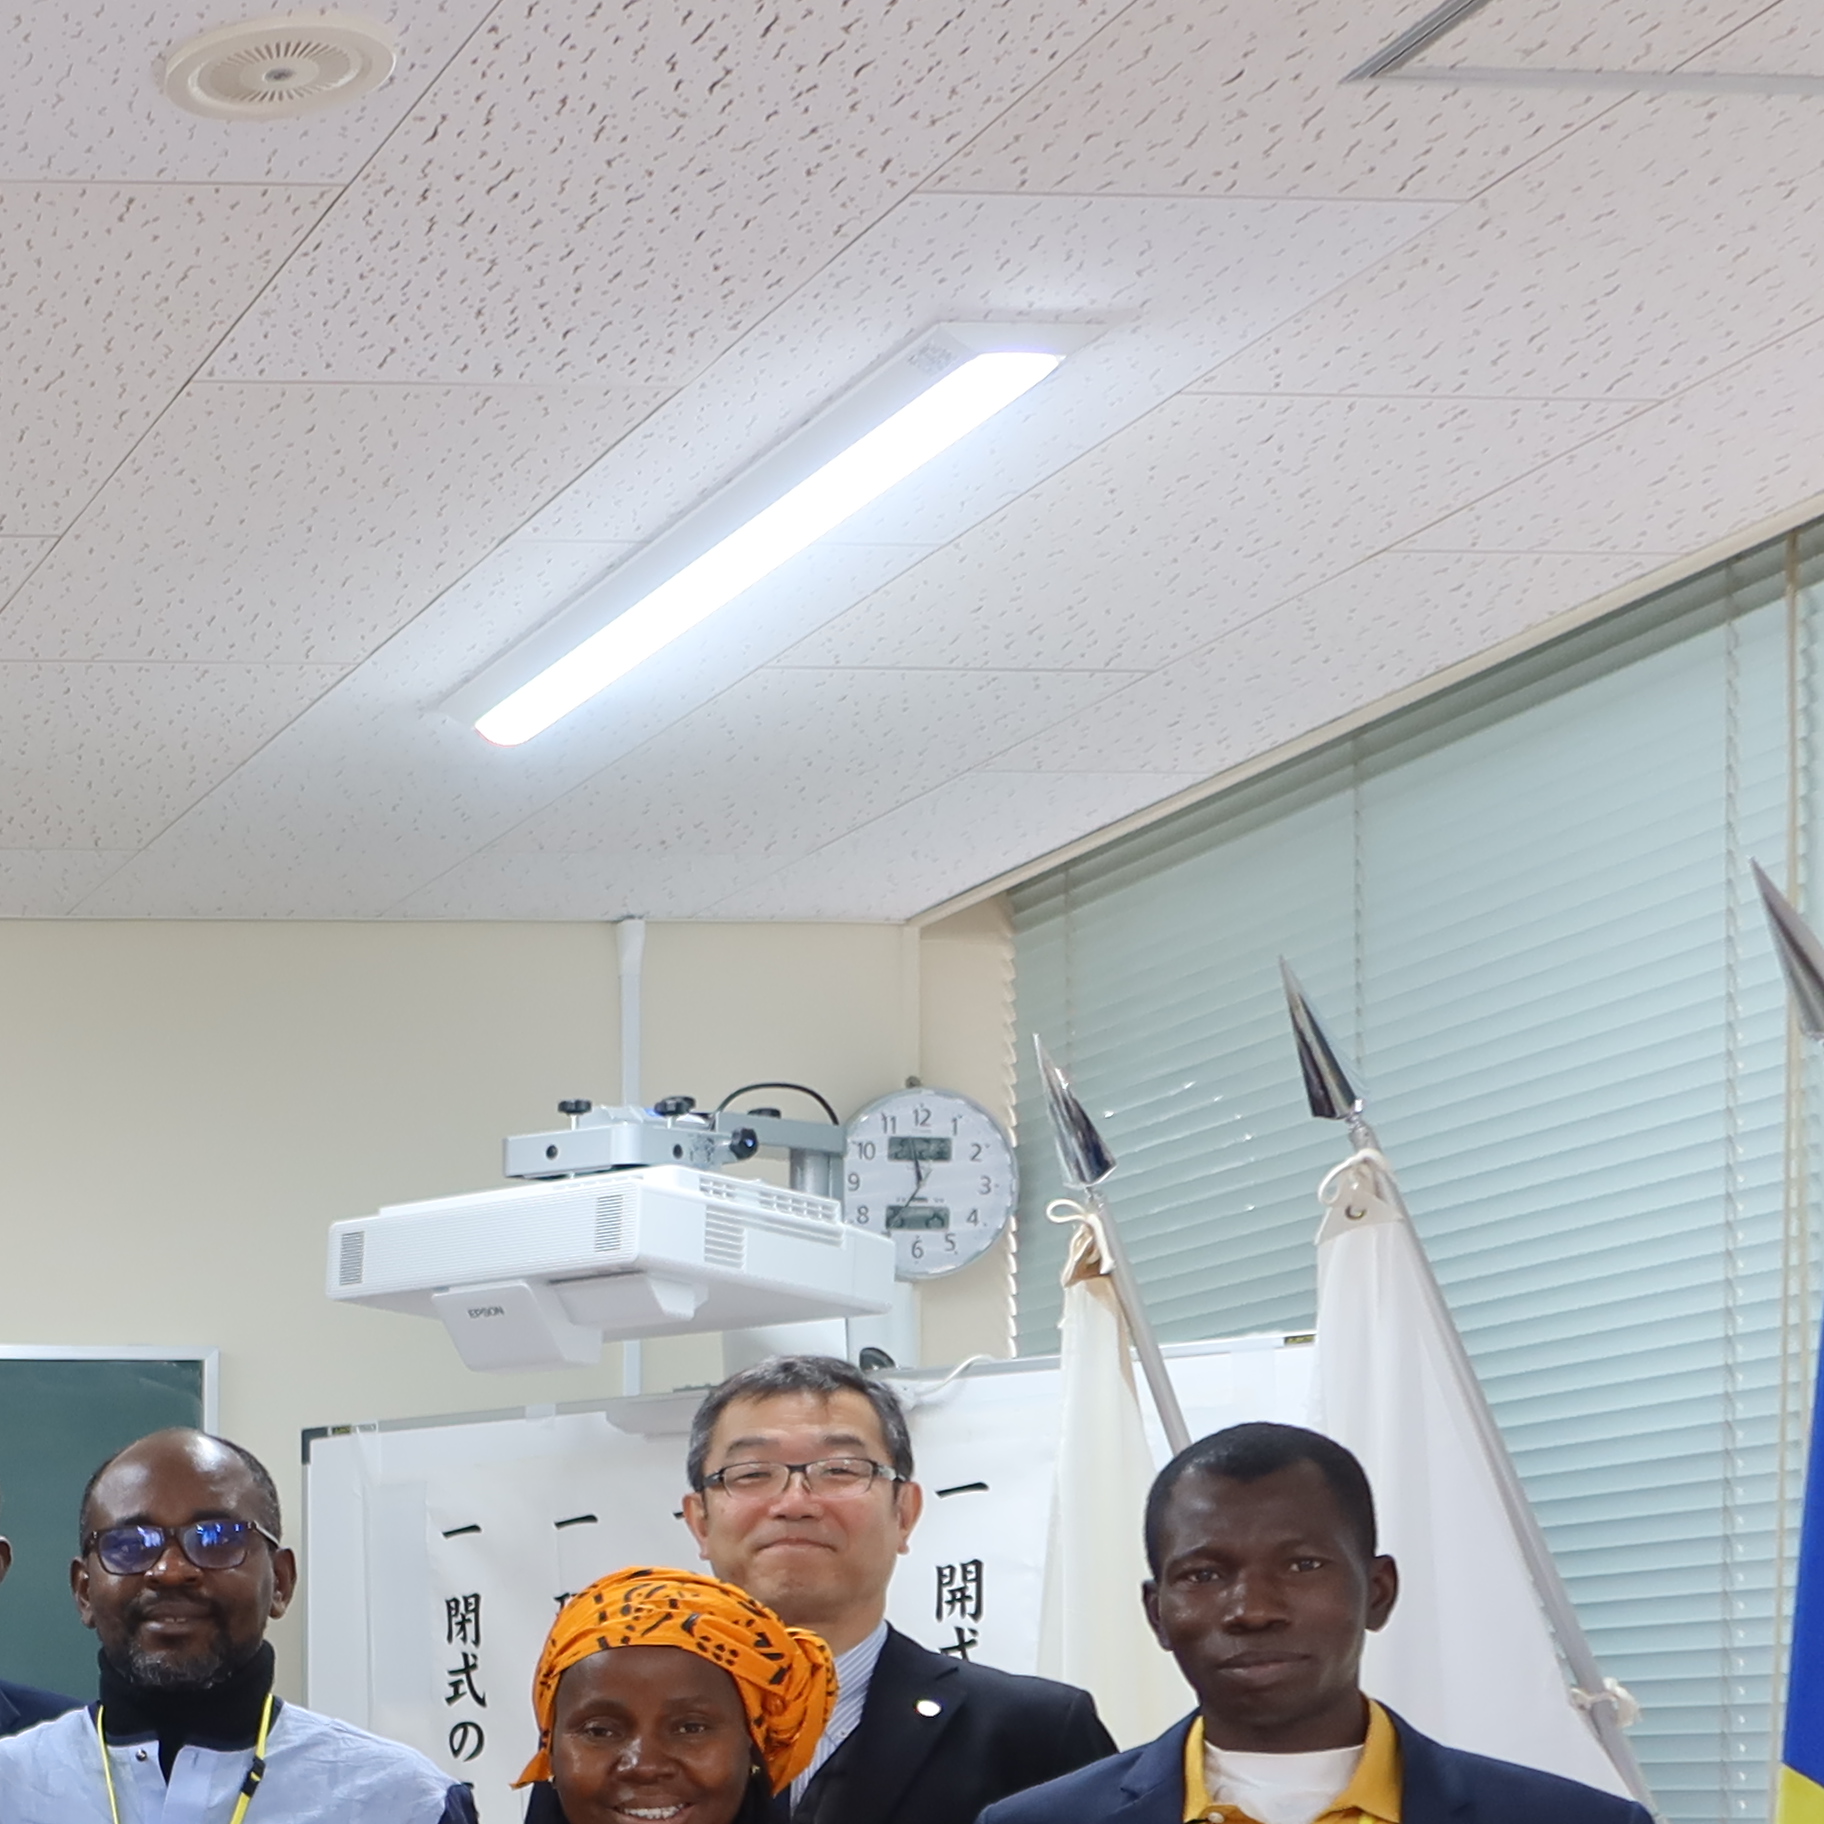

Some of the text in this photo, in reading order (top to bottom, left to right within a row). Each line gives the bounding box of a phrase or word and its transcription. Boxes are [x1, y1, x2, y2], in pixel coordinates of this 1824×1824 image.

[913, 1109, 931, 1127] 12
[858, 1142, 876, 1160] 10
[970, 1143, 982, 1162] 2
[848, 1172, 860, 1191] 9
[980, 1176, 992, 1195] 3
[856, 1205, 869, 1224] 8
[966, 1208, 979, 1227] 4
[911, 1240, 924, 1259] 6
[944, 1233, 956, 1251] 5
[468, 1306, 505, 1319] EPSON
[445, 1592, 488, 1788] 閉式の
